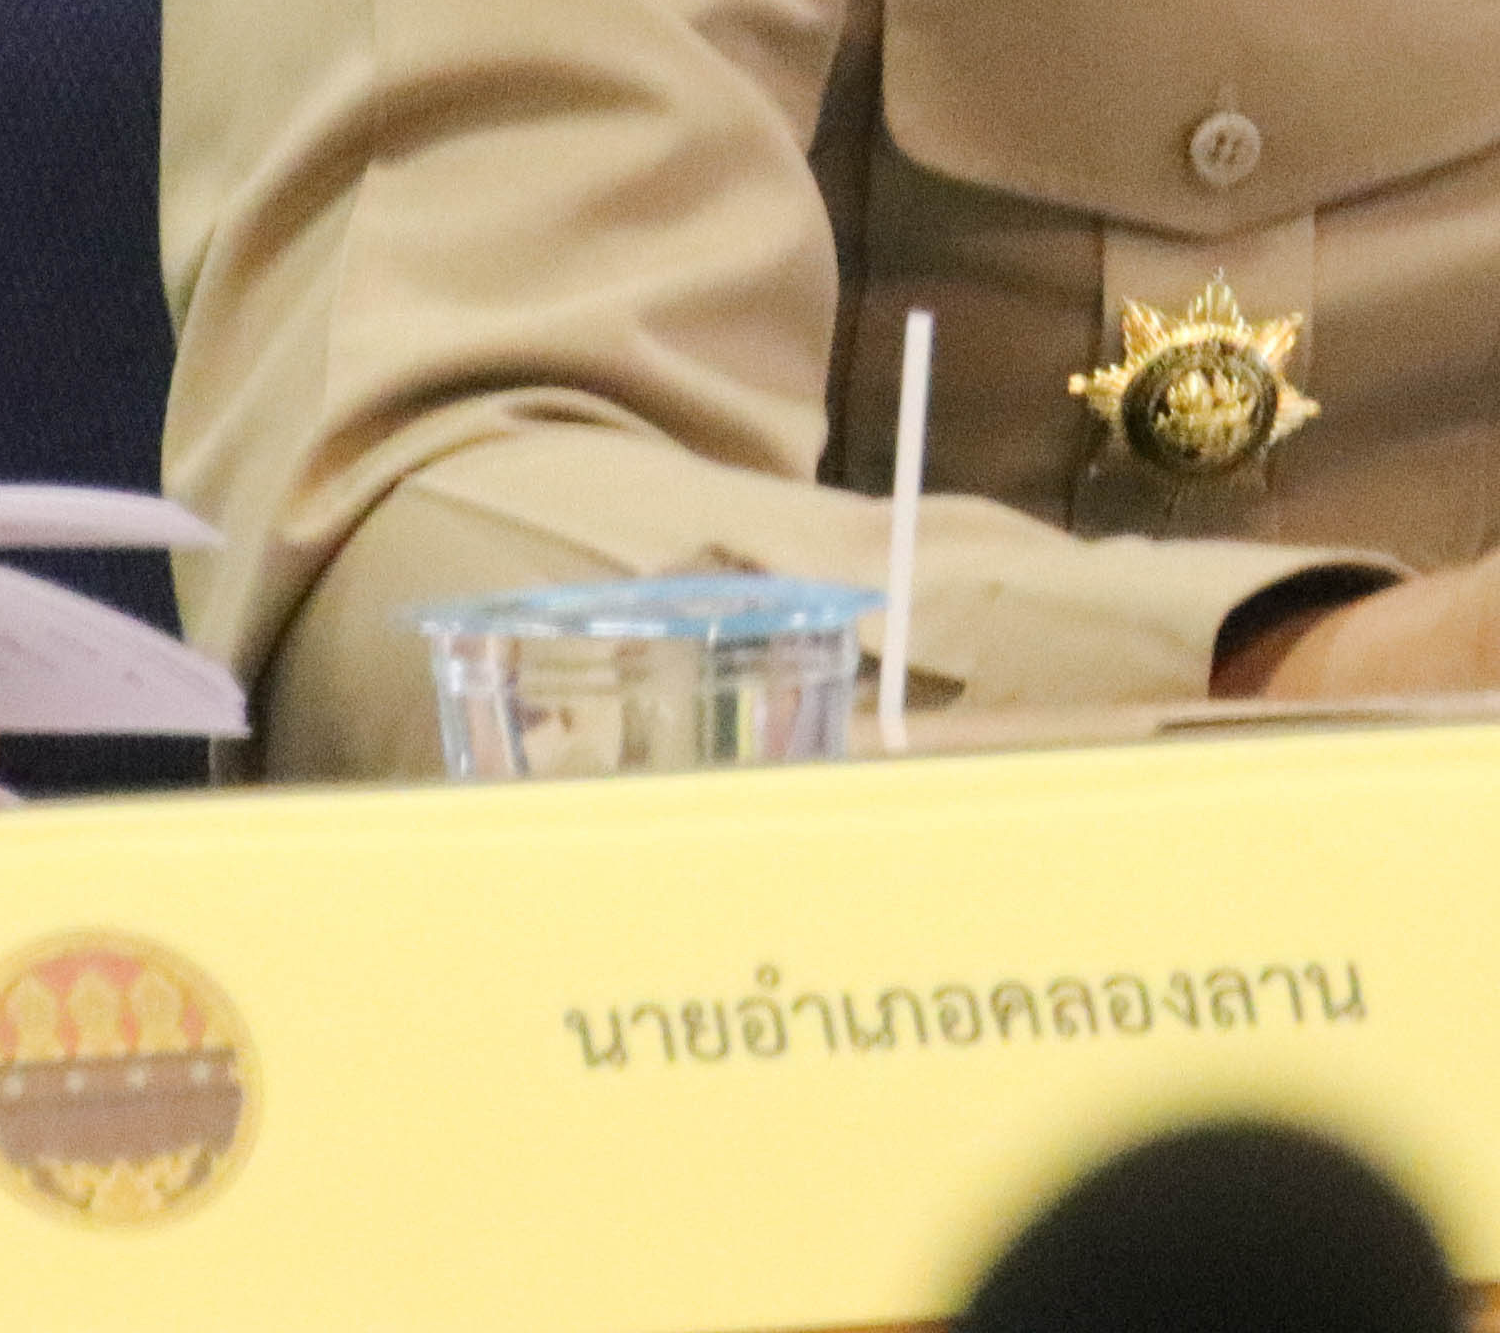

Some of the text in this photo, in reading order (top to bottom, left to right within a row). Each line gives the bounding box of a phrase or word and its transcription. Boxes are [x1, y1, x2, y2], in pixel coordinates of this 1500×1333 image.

[564, 961, 1368, 1071] นายอำเภอคลองลาน
